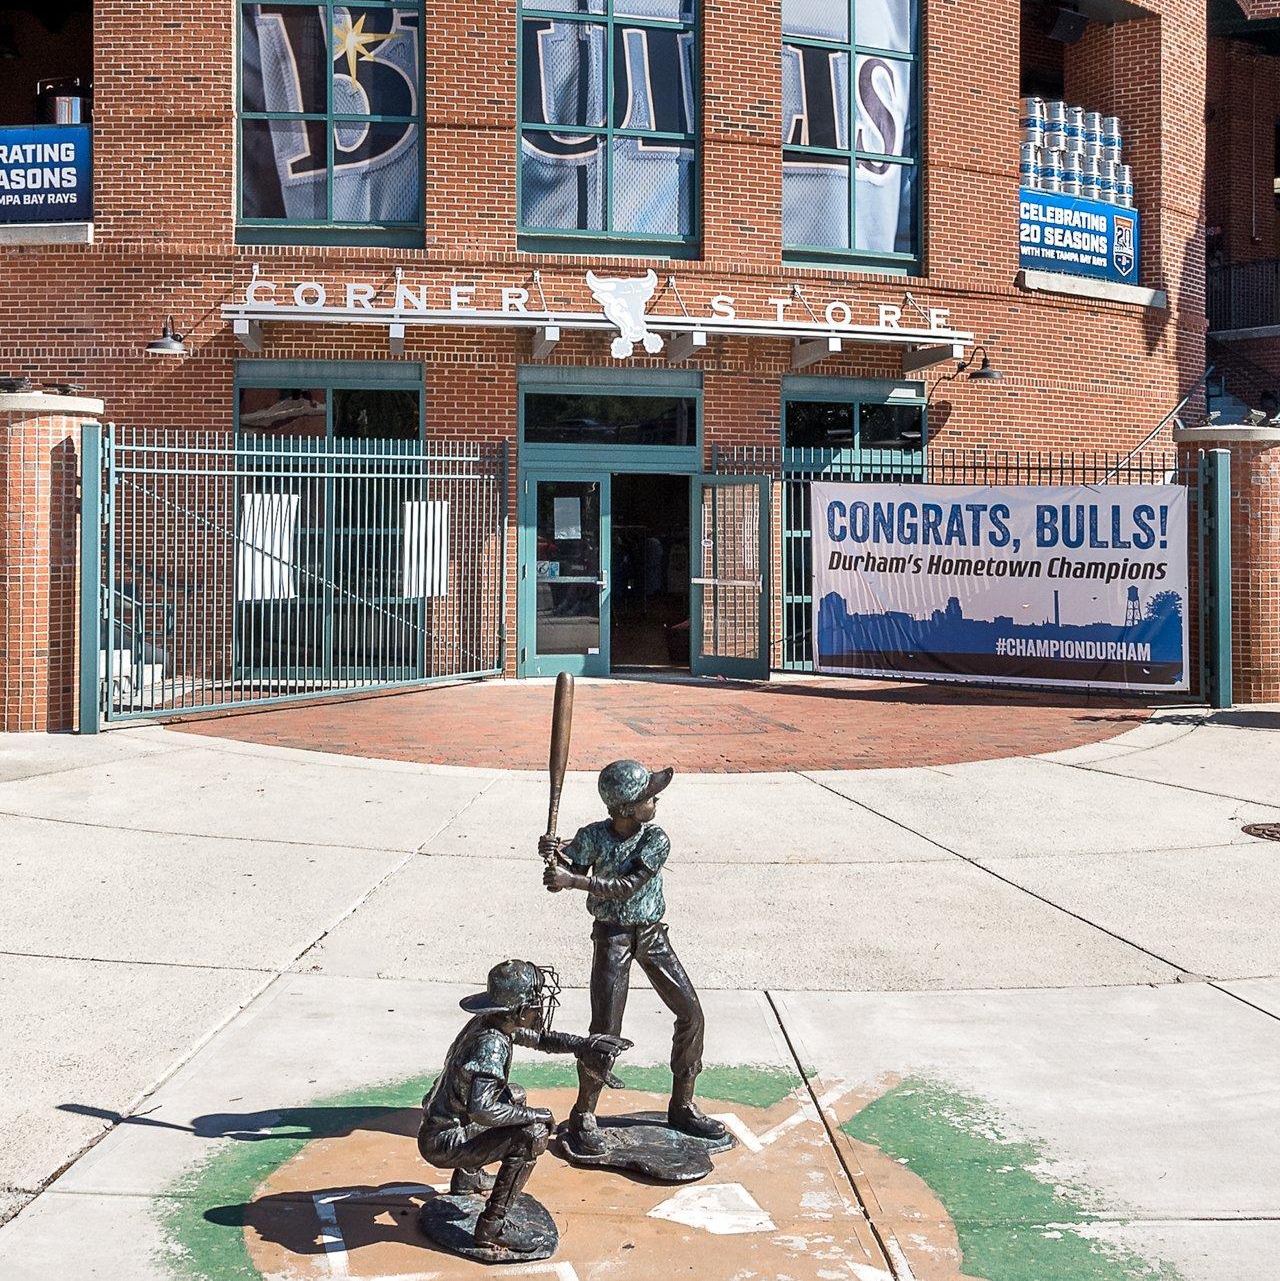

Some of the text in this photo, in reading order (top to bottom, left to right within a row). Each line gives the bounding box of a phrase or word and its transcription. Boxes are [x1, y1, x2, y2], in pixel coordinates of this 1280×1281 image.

[23, 194, 45, 205] BAY
[47, 193, 77, 204] RAYS
[1020, 202, 1107, 233] CELEBRATING
[1020, 223, 1108, 255] 20 SEASONS
[1020, 245, 1040, 257] WITH
[1041, 247, 1055, 259] THE
[246, 280, 952, 331] CORNER STORE
[827, 500, 1169, 554] CONGRATS, BULLS!
[828, 552, 1168, 585] Durham's Hometown Champions
[995, 637, 1151, 662] #CHAMPIONDURHAM
